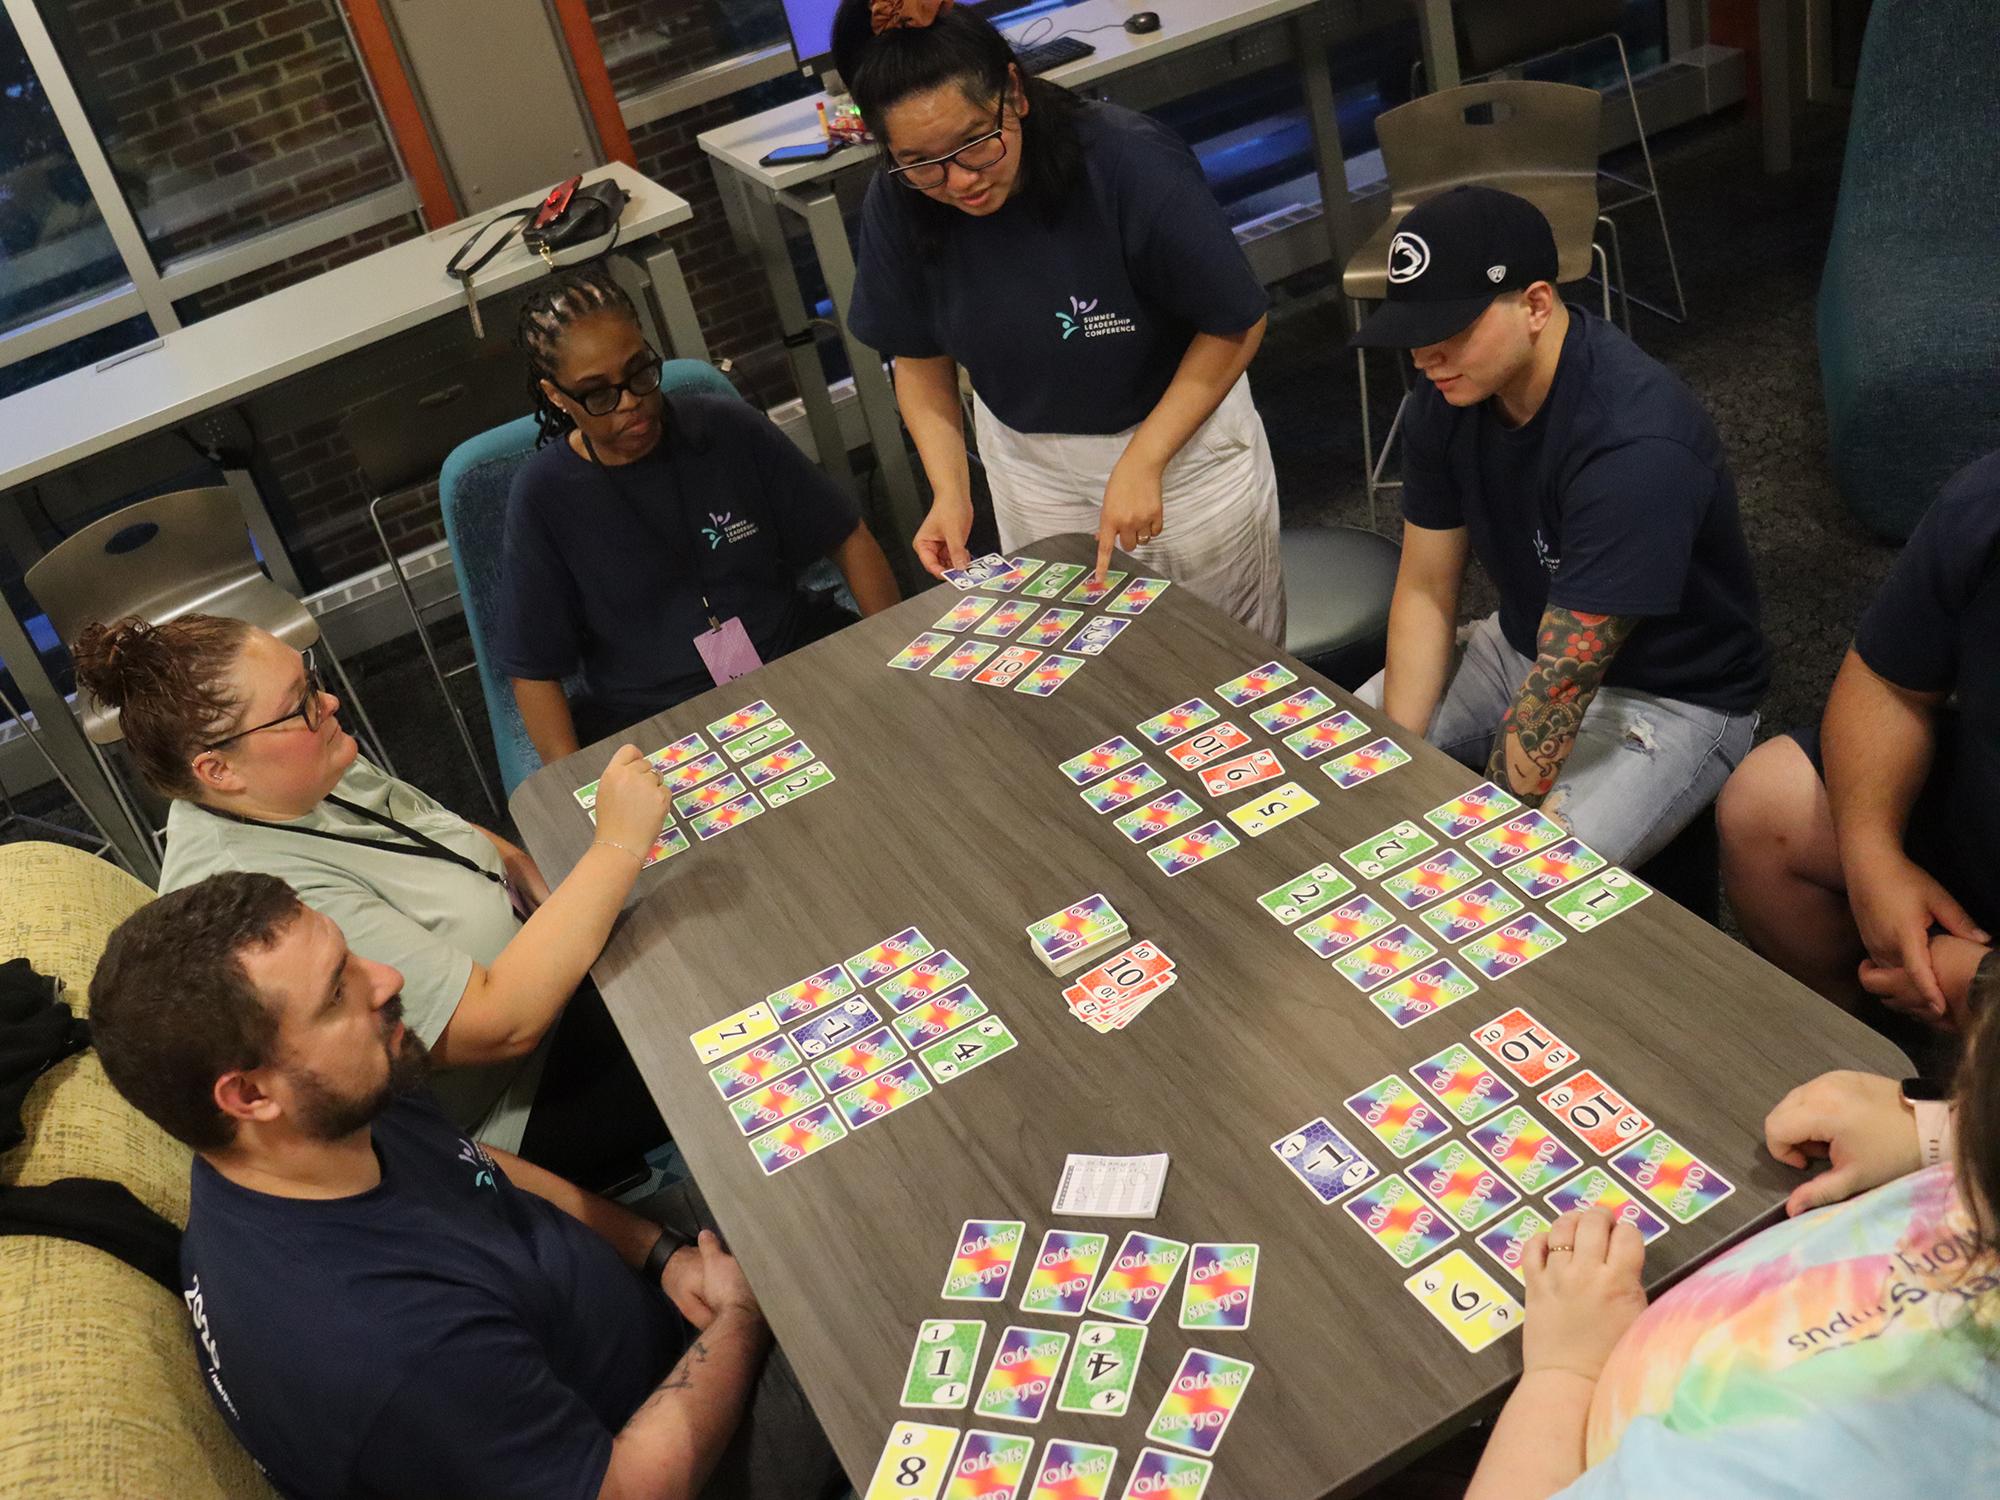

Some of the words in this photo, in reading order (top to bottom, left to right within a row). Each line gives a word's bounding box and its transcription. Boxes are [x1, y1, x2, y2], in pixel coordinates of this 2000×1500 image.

[1084, 313, 1115, 323] SUMMER
[1085, 319, 1130, 330] LEADERSHIP
[1085, 325, 1135, 337] CONFERENCE
[996, 660, 1022, 673] 10
[748, 735, 767, 746] 1
[1193, 736, 1226, 757] 10
[786, 778, 808, 791] 2
[1258, 802, 1288, 816] 5
[1376, 840, 1404, 859] 2
[1368, 864, 1378, 872] 2
[1291, 884, 1320, 904] 2
[1586, 889, 1616, 909] 1
[1285, 908, 1296, 916] 2
[1135, 948, 1149, 958] 10
[1104, 957, 1144, 986] 10
[1101, 988, 1115, 998] 10
[720, 1023, 747, 1040] 7
[824, 1019, 851, 1042] -1
[1484, 1030, 1500, 1042] 10
[1501, 1028, 1550, 1062] 10
[954, 1044, 983, 1061] 4
[1548, 1051, 1565, 1063] 10
[1551, 1093, 1569, 1106] 10
[1571, 1092, 1622, 1128] 10
[1620, 1117, 1638, 1130] 10
[1288, 1143, 1300, 1152] -1
[1308, 1144, 1351, 1170] -1
[1349, 1168, 1361, 1177] -1
[933, 1330, 939, 1339] 1
[1092, 1334, 1101, 1343] 4
[929, 1349, 952, 1375] 1
[1088, 1353, 1119, 1381] 4
[950, 1386, 955, 1396] 1
[1106, 1392, 1115, 1403] 4
[903, 1433, 912, 1444] 8
[896, 1456, 926, 1485] 8
